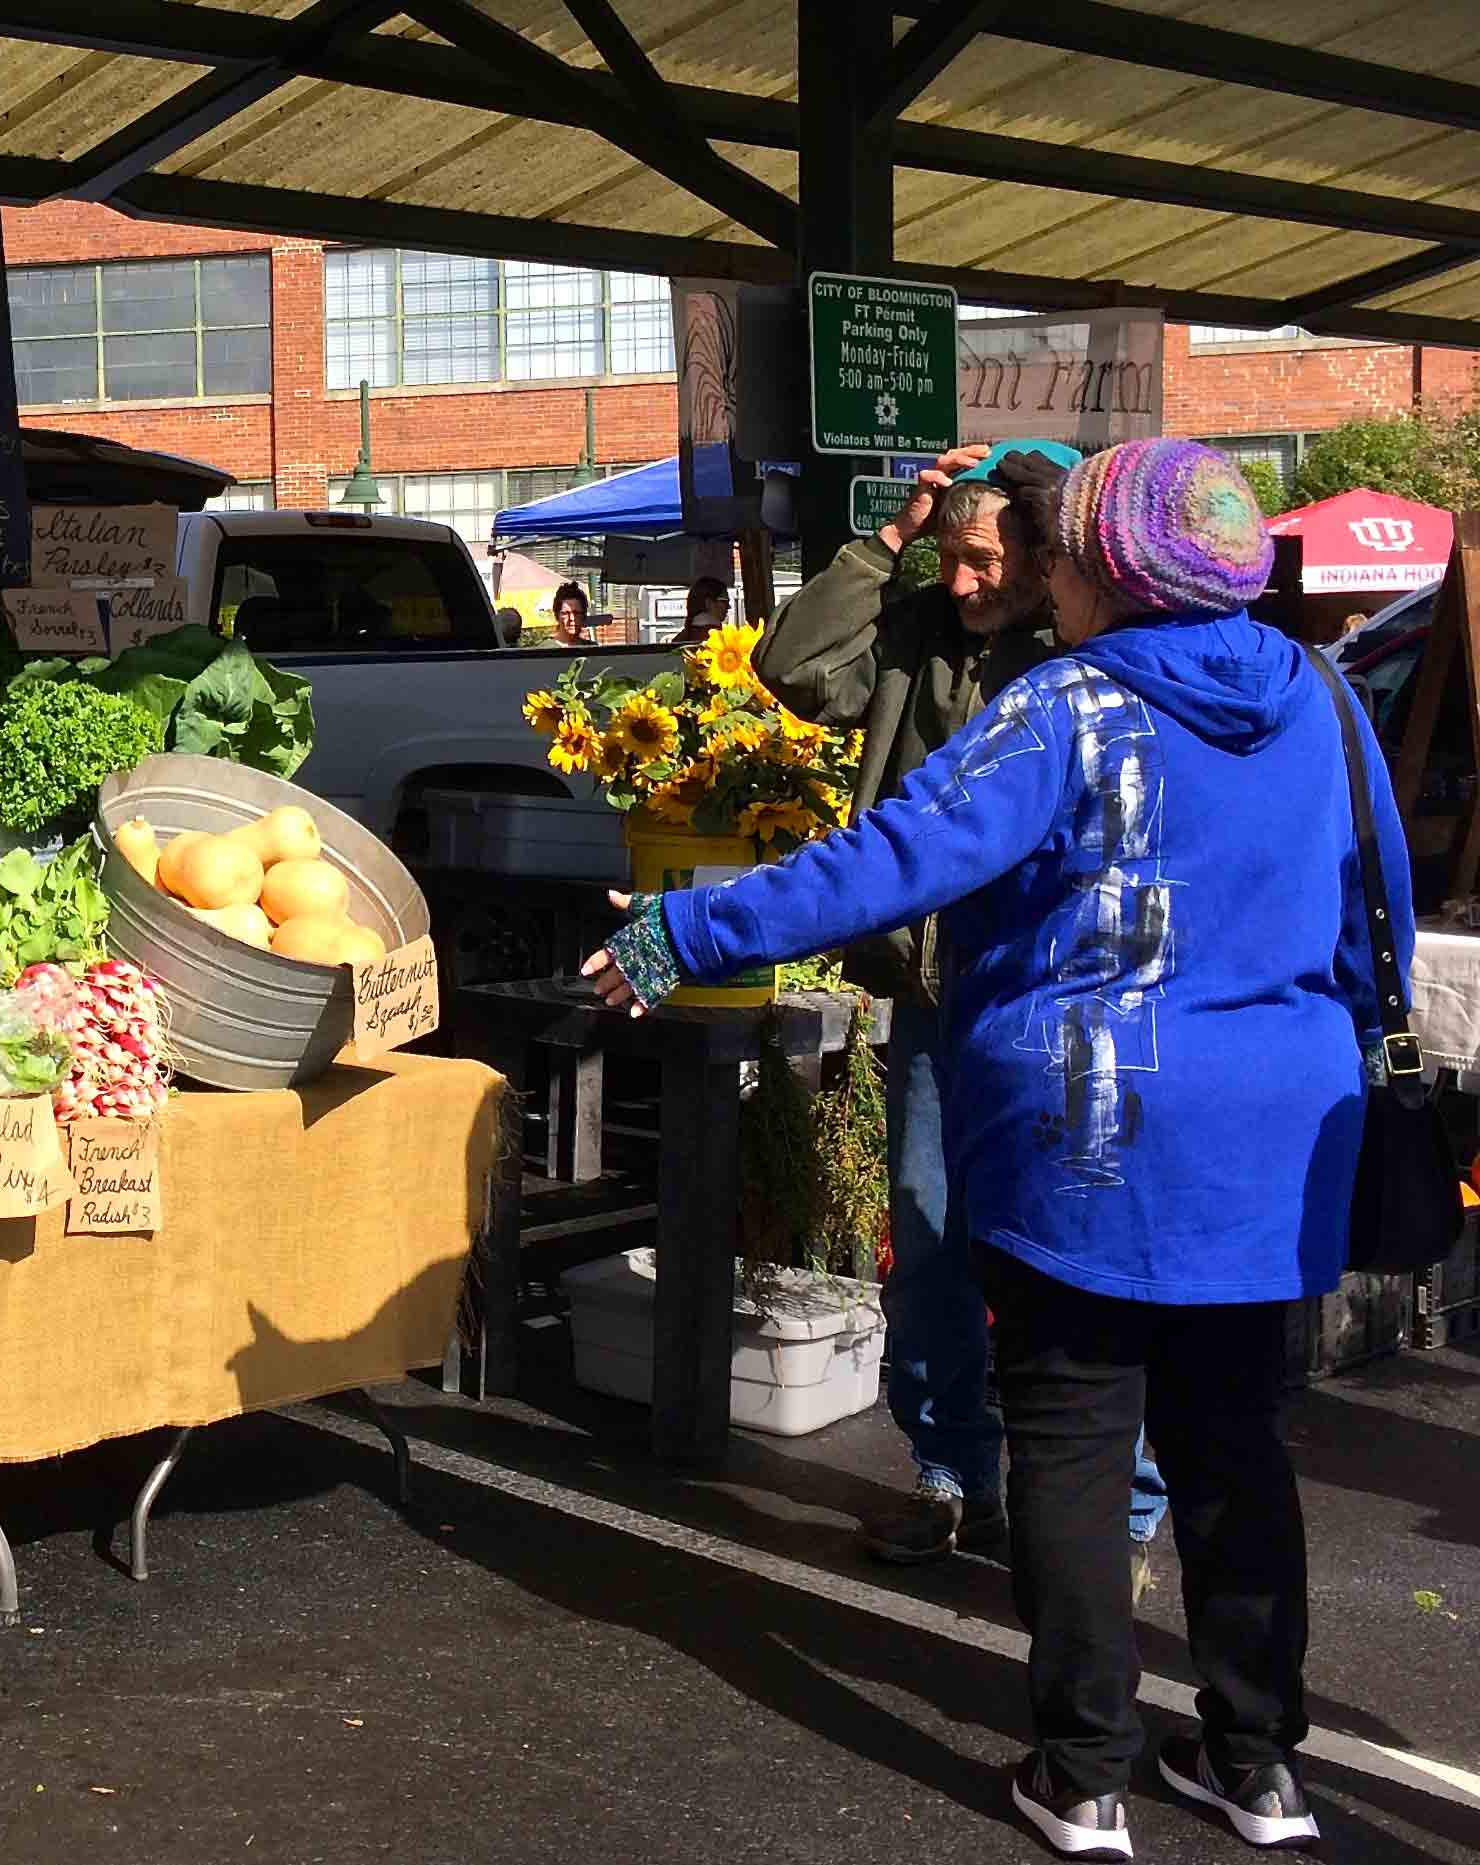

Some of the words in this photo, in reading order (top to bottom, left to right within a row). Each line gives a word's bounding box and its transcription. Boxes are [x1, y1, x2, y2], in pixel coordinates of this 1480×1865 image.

[815, 282, 843, 299] CITY
[847, 285, 864, 300] OF
[867, 287, 953, 309] BLOOMINGTON
[854, 303, 871, 319] FT
[875, 305, 916, 323] Permit
[841, 320, 894, 343] Parking
[898, 324, 929, 346] Only
[840, 340, 930, 374] Monday-Friday
[839, 367, 862, 390] 5:00
[917, 376, 934, 397] pm
[1035, 349, 1153, 414] Farm
[823, 432, 871, 447] Violators
[872, 434, 894, 448] Will
[897, 436, 911, 449] Be
[914, 436, 949, 450] Towed
[866, 482, 878, 498] NO
[880, 484, 911, 499] PARKING
[35, 507, 148, 549] Italian
[40, 546, 132, 580] Parsley
[1320, 567, 1397, 585] INDIANA
[110, 585, 185, 623] Collards
[358, 947, 435, 1006] Butternut
[365, 984, 423, 1039] Squash
[79, 1136, 141, 1163] French
[80, 1200, 132, 1226] Radish
[132, 1202, 152, 1227] $3
